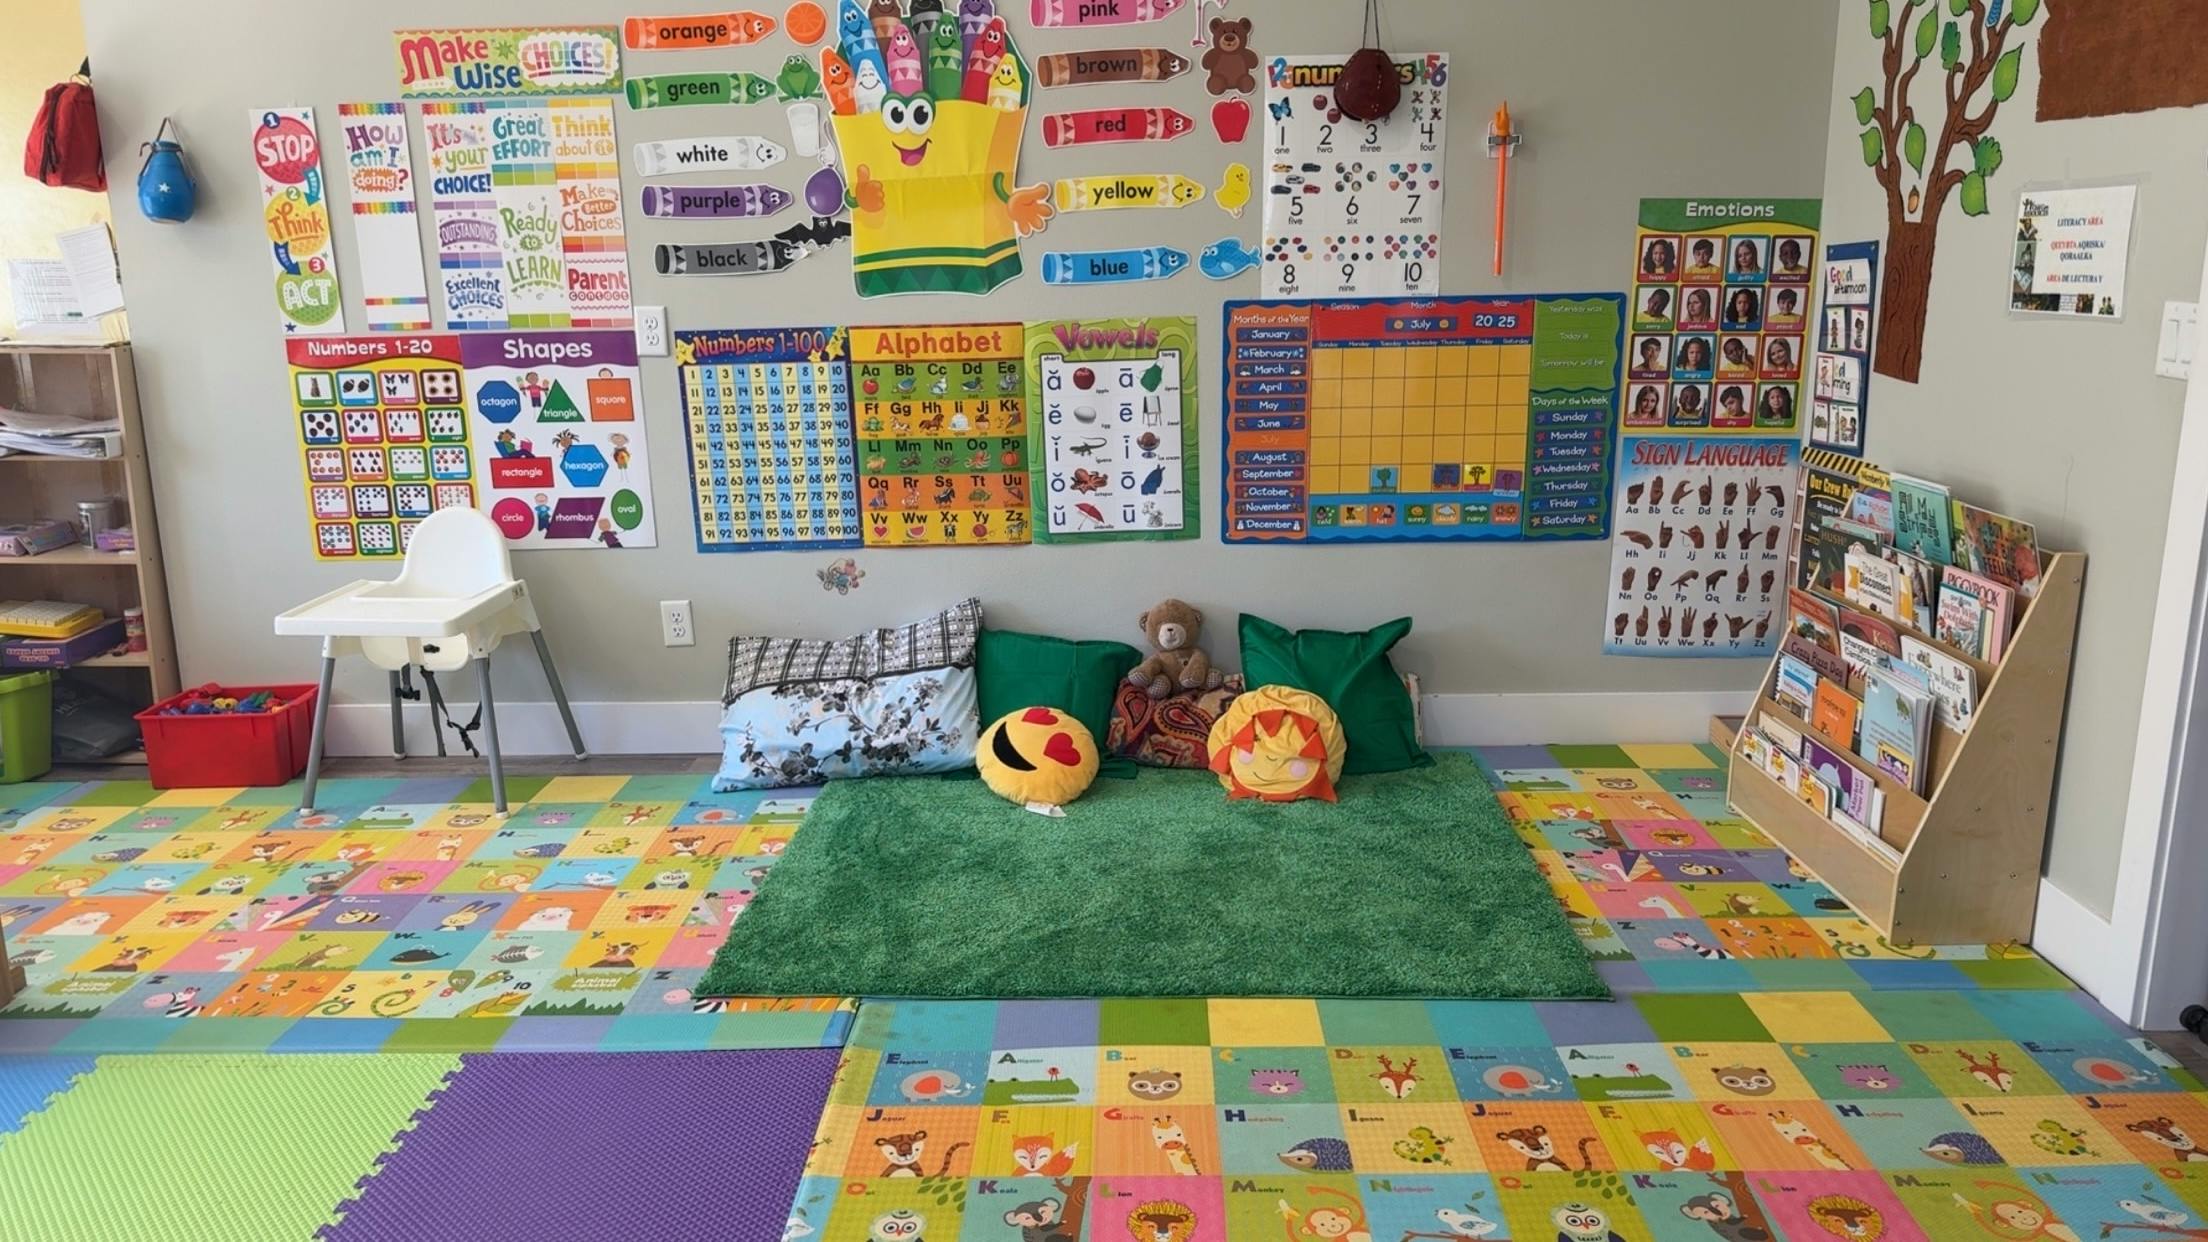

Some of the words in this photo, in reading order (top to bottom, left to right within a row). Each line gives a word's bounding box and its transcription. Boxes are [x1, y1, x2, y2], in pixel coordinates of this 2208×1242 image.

[1079, 0, 1119, 22] pink
[660, 21, 728, 42] orange
[401, 35, 488, 85] Make
[521, 41, 613, 70] CHOICES!
[1076, 55, 1138, 75] brown
[454, 63, 521, 89] Wise
[667, 79, 721, 101] green
[493, 116, 546, 138] Great
[552, 114, 612, 137] Think
[1095, 116, 1126, 133] red
[348, 125, 402, 150] How
[428, 124, 462, 148] It's
[1281, 127, 1285, 145] 1
[1320, 125, 1332, 145] 2
[1365, 124, 1377, 144] 3
[1421, 123, 1434, 142] 4
[255, 135, 315, 167] STOP
[494, 140, 550, 160] EFFORT
[556, 138, 594, 156] about
[676, 145, 729, 163] white
[350, 150, 384, 167] am
[388, 147, 399, 167] I
[445, 148, 488, 172] your
[356, 169, 408, 190] doing?
[434, 173, 491, 194] CHOICE!
[561, 184, 605, 201] Make
[1093, 182, 1155, 203] yellow
[679, 191, 741, 214] purple
[1291, 197, 1303, 216] 5
[1347, 196, 1358, 215] 6
[1408, 195, 1420, 214] 7
[1686, 202, 1774, 217] Emotions
[269, 202, 324, 240] Think
[503, 206, 557, 243] Ready
[563, 209, 622, 231] Choices
[2057, 218, 2086, 226] LITERACY
[2087, 216, 2104, 226] AREA
[440, 222, 496, 241] OUTSTANDING
[312, 260, 321, 271] 3
[697, 250, 747, 268] black
[1090, 257, 1129, 278] blue
[508, 257, 562, 282] LEARN
[1284, 264, 1295, 283] 8
[1342, 264, 1354, 282] 9
[1404, 263, 1422, 281] 10
[447, 278, 500, 293] Excellent
[569, 268, 628, 291] Parent
[282, 279, 332, 309] ACT
[1279, 285, 1299, 294] eight
[449, 290, 503, 310] CHOICES
[1234, 315, 1266, 323] Months
[1289, 314, 1309, 323] Year
[1411, 320, 1431, 330] July
[1476, 315, 1492, 327] 20
[1498, 316, 1515, 328] 25
[1053, 322, 1160, 350] Vowels
[1251, 330, 1290, 340] January
[308, 341, 387, 355] Numbers
[396, 341, 432, 354] 1-20
[504, 340, 593, 362] Shapes
[695, 336, 774, 356] Numbers
[779, 332, 826, 353] 1-100
[876, 332, 1001, 357] Alphabet
[1249, 348, 1291, 358] February
[705, 369, 713, 379] 2
[722, 369, 729, 379] 3
[738, 368, 745, 378] 4
[754, 368, 761, 377] 5
[770, 368, 777, 377] 6
[786, 367, 792, 376] 7
[802, 366, 809, 376] 8
[817, 366, 824, 375] 9
[832, 365, 842, 375] 10
[861, 365, 880, 376] Aa
[895, 364, 914, 376] Bb
[927, 364, 946, 376] Cc
[963, 363, 982, 375] Dd
[998, 362, 1016, 374] Ee
[1255, 364, 1284, 374] March
[1259, 383, 1281, 393] April
[480, 397, 516, 408] octagon
[596, 396, 626, 406] square
[1260, 402, 1279, 411] May
[1532, 397, 1557, 407] Days
[1582, 396, 1608, 405] Week
[544, 408, 577, 419] triangle
[1552, 412, 1588, 422] Sunday
[1258, 418, 1280, 428] June
[1551, 430, 1587, 440] Monday
[1253, 453, 1287, 464] August
[1549, 447, 1586, 456] Tuesday
[1632, 440, 1681, 465] SIGN
[1685, 440, 1790, 467] LANGUAGE
[502, 466, 543, 478] rectangle
[565, 461, 604, 472] hexagon
[1243, 470, 1293, 480] September
[1542, 462, 1591, 472] Wednesday
[1544, 481, 1588, 491] Thursday
[1810, 474, 1822, 491] Our
[1249, 487, 1288, 496] October
[618, 505, 636, 513] oval
[1246, 502, 1291, 511] November
[1550, 499, 1578, 509] Friday
[502, 513, 524, 522] circle
[556, 513, 593, 522] rhombus
[1246, 519, 1292, 528] December
[1542, 514, 1586, 524] Saturday
[1232, 1180, 1285, 1194] Monkey
